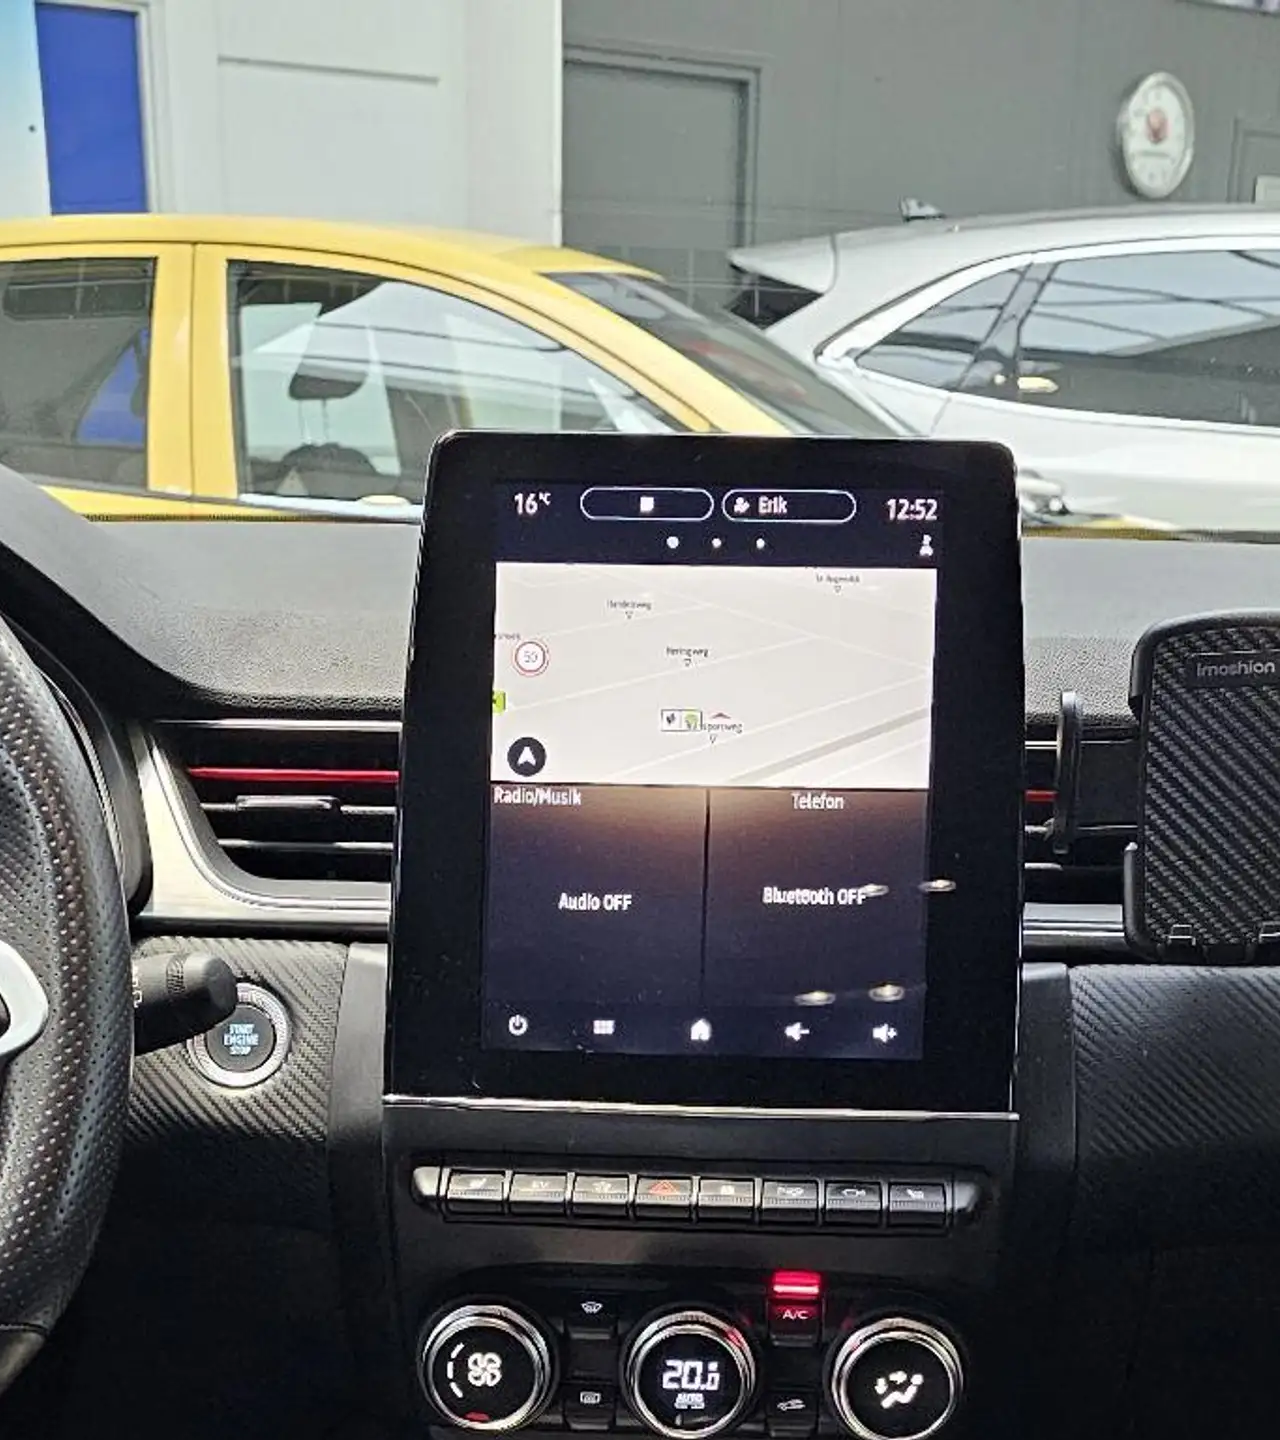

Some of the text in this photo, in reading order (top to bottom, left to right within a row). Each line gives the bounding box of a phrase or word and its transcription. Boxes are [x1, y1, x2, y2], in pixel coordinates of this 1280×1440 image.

[758, 494, 788, 514] Erik
[887, 499, 938, 521] 12:52
[1196, 660, 1276, 677] imoshion
[493, 786, 582, 806] Radio/Musik
[792, 792, 844, 810] Telefon
[558, 892, 632, 911] Audio OFF
[763, 886, 867, 906] Bluetooth OFF
[782, 1309, 809, 1320] A/C
